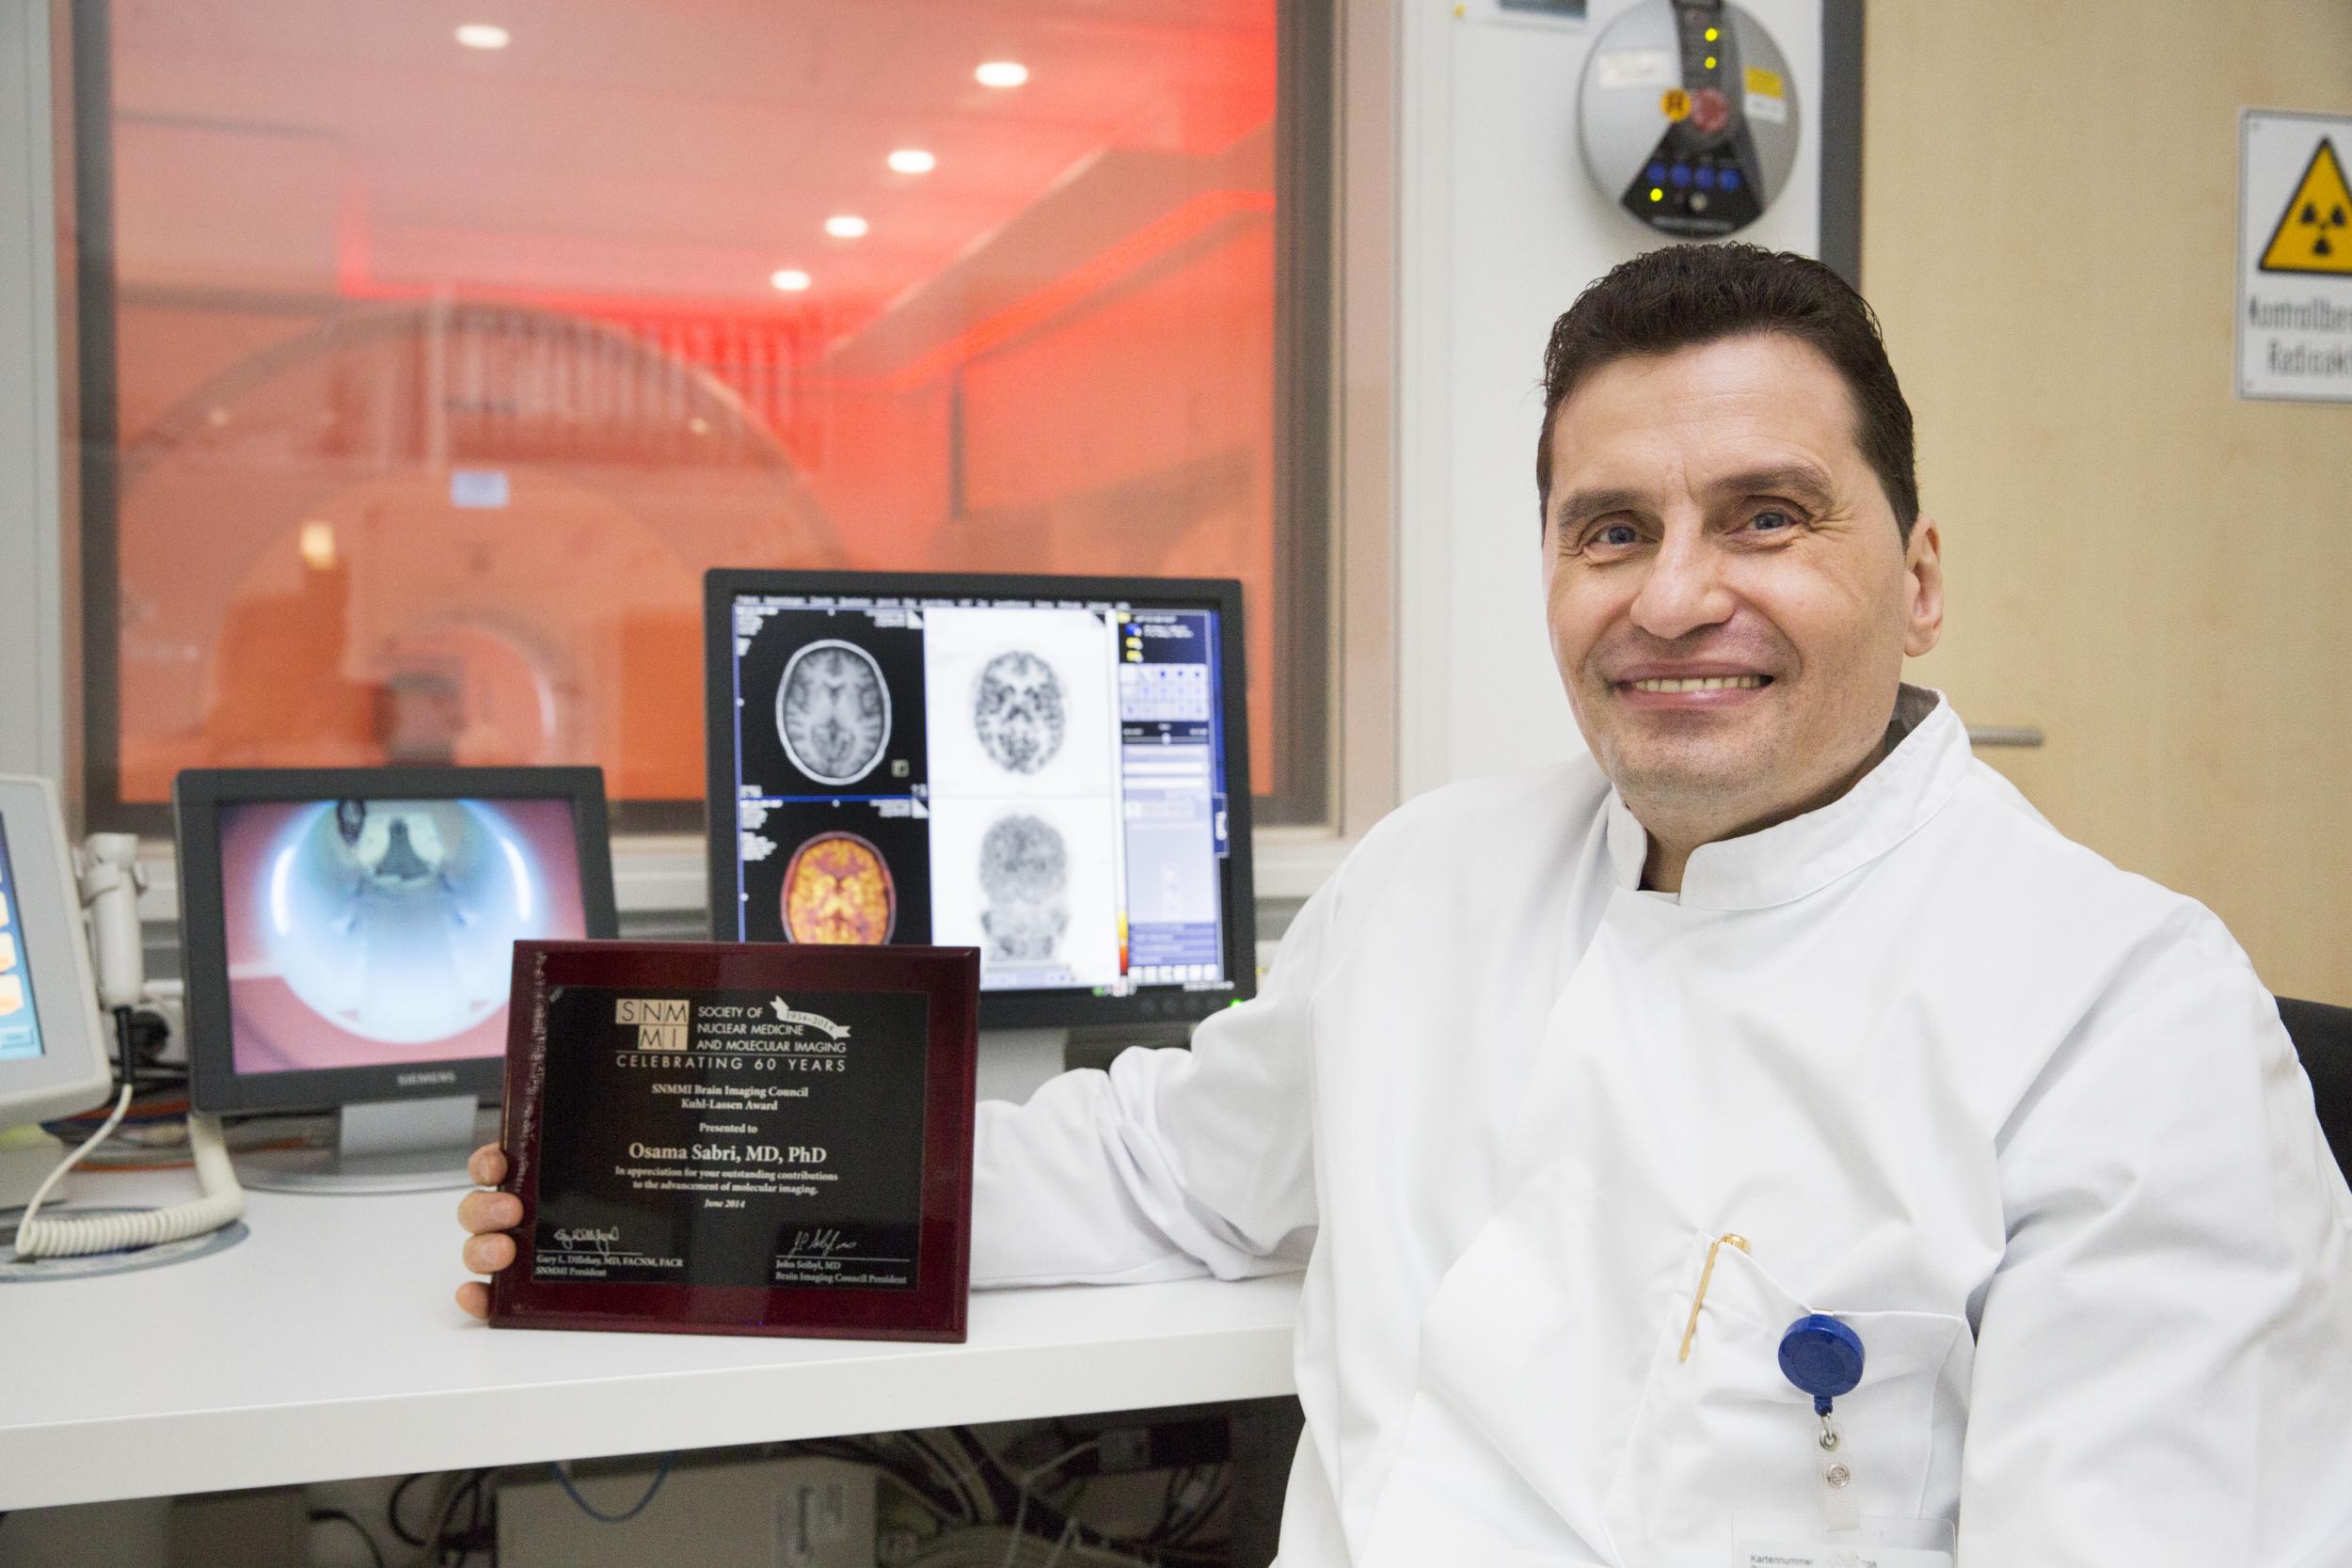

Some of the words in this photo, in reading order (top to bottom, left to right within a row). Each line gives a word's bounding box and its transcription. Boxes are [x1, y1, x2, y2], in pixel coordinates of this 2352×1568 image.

[621, 1001, 688, 1022] SNM
[698, 1006, 743, 1018] SOCIETY
[747, 1006, 763, 1018] OF
[697, 1023, 748, 1035] NUCLEAR
[751, 1024, 804, 1036] MEDICINE
[696, 1040, 722, 1051] AND
[725, 1040, 790, 1053] MOLECULAR
[794, 1041, 847, 1053] IMAGING
[616, 1055, 743, 1069] CELEBRATING
[754, 1057, 777, 1070] 60
[788, 1058, 846, 1071] YEARS
[652, 1085, 691, 1095] SNMMI
[694, 1085, 723, 1096] Brain
[724, 1085, 767, 1099] Imaging
[769, 1086, 809, 1098] Council
[681, 1099, 743, 1111] Kuhl-Lassen
[745, 1101, 778, 1111] Award
[699, 1122, 745, 1133] Presented
[747, 1124, 758, 1133] to
[628, 1143, 688, 1160] Osama
[691, 1144, 741, 1163] Sabri,
[745, 1146, 784, 1164] MD,
[787, 1147, 827, 1164] PhD
[615, 1165, 626, 1176] In
[628, 1166, 683, 1178] appreciation
[684, 1167, 698, 1177] for
[699, 1169, 721, 1180] your
[722, 1169, 775, 1181] outstanding
[777, 1170, 838, 1181] contributions
[632, 1180, 643, 1190] to
[644, 1180, 659, 1190] the
[660, 1180, 719, 1192] advancement
[721, 1181, 731, 1192] of
[732, 1182, 778, 1193] molecular
[705, 1198, 724, 1209] June
[725, 1199, 745, 1209] 2014
[536, 1255, 557, 1265] Gary
[604, 1257, 622, 1267] MD,
[623, 1258, 658, 1268] FACNM,
[775, 1259, 795, 1269] John
[825, 1261, 841, 1270] MD
[569, 1268, 607, 1277] President
[775, 1271, 799, 1280] Brain
[800, 1273, 834, 1284] Imaging
[835, 1273, 867, 1283] Council
[869, 1275, 907, 1284] President
[1750, 1554, 1814, 1566] Kartennummer
